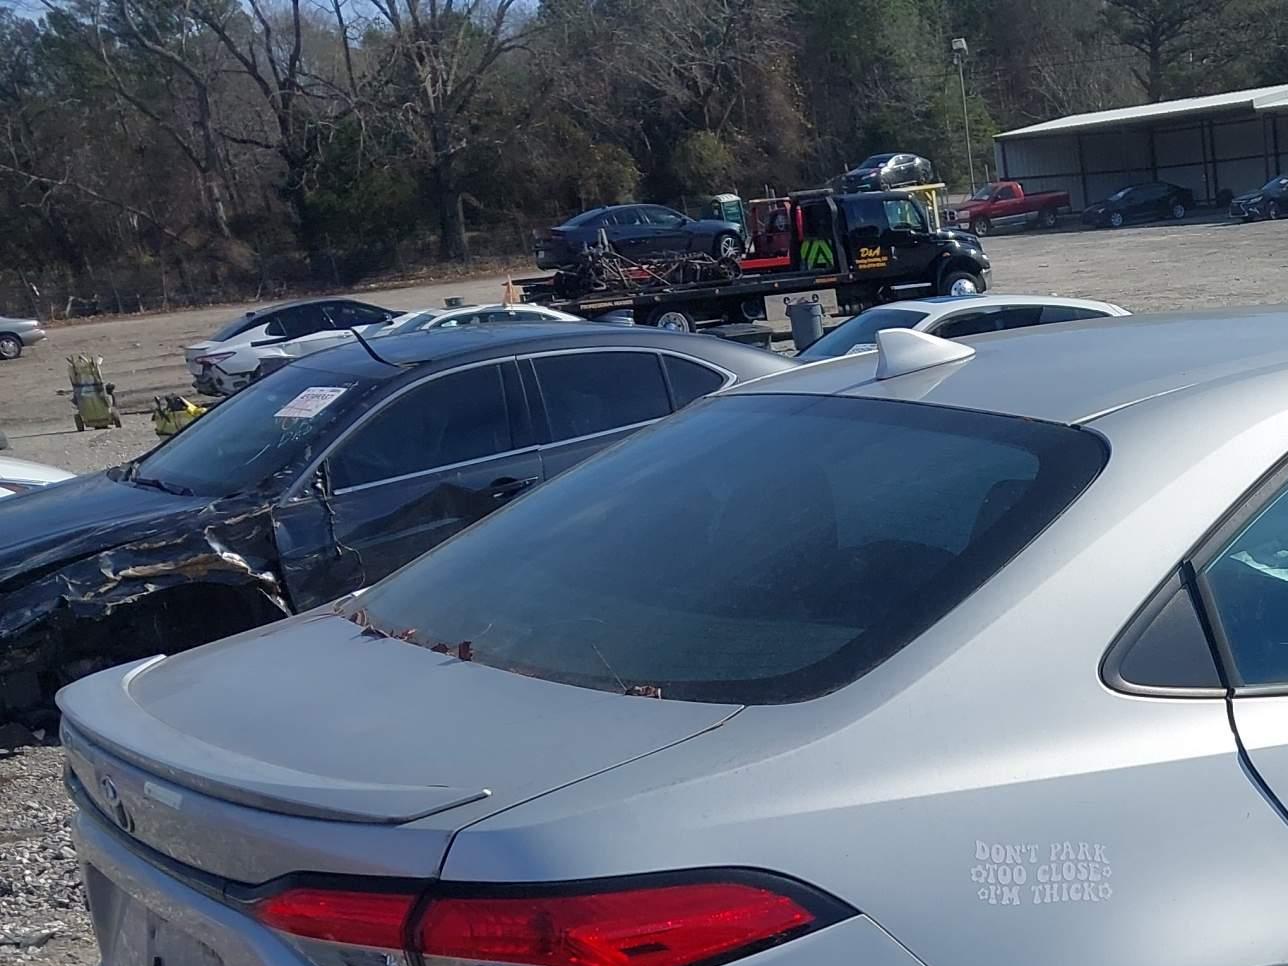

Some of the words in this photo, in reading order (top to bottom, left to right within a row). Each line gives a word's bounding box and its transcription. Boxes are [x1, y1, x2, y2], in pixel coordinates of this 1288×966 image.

[975, 839, 1039, 864] DON'T
[1049, 840, 1110, 864] PARK
[985, 863, 1027, 885] TOO
[1036, 861, 1101, 883] CLOSE
[988, 885, 1021, 905] I'M
[1031, 882, 1100, 904] THICK
